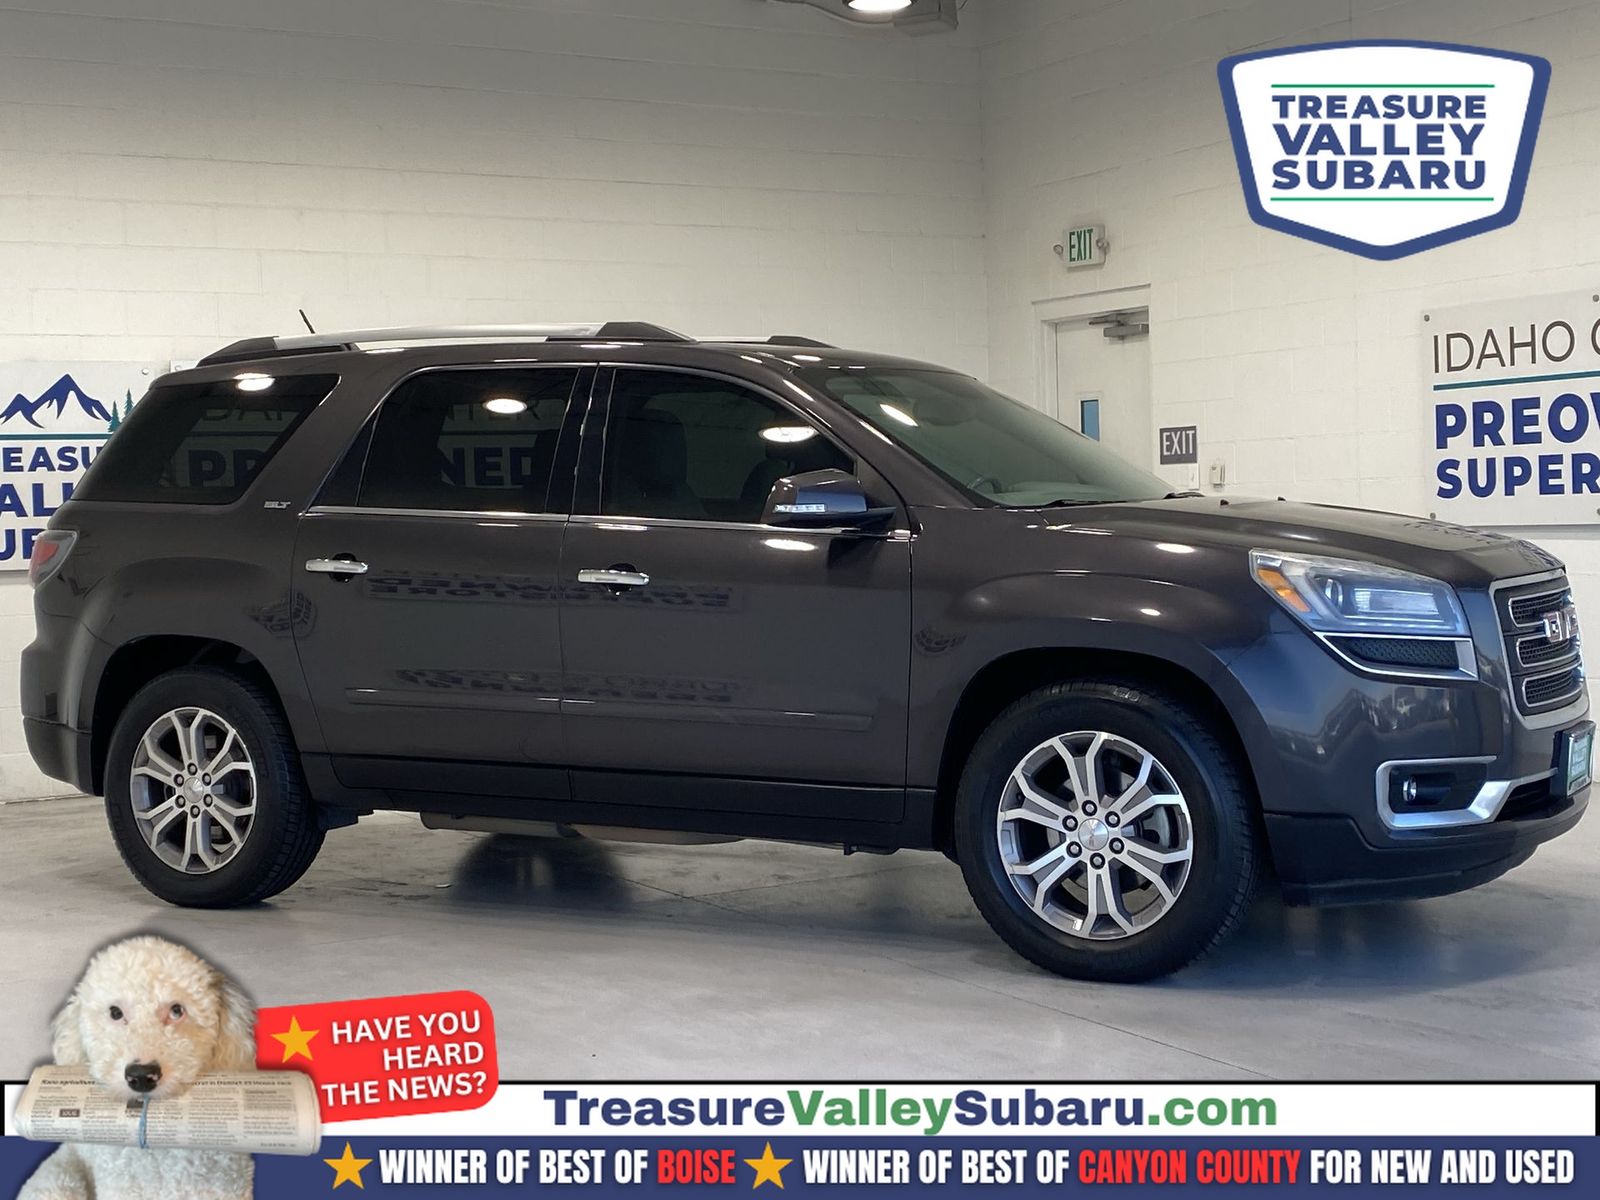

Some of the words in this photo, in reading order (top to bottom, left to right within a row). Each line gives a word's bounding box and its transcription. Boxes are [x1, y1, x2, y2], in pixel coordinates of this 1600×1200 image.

[1069, 228, 1094, 262] EXIT
[1433, 320, 1576, 374] IDAHO
[1435, 392, 1600, 450] PREO
[1163, 430, 1196, 457] EXIT
